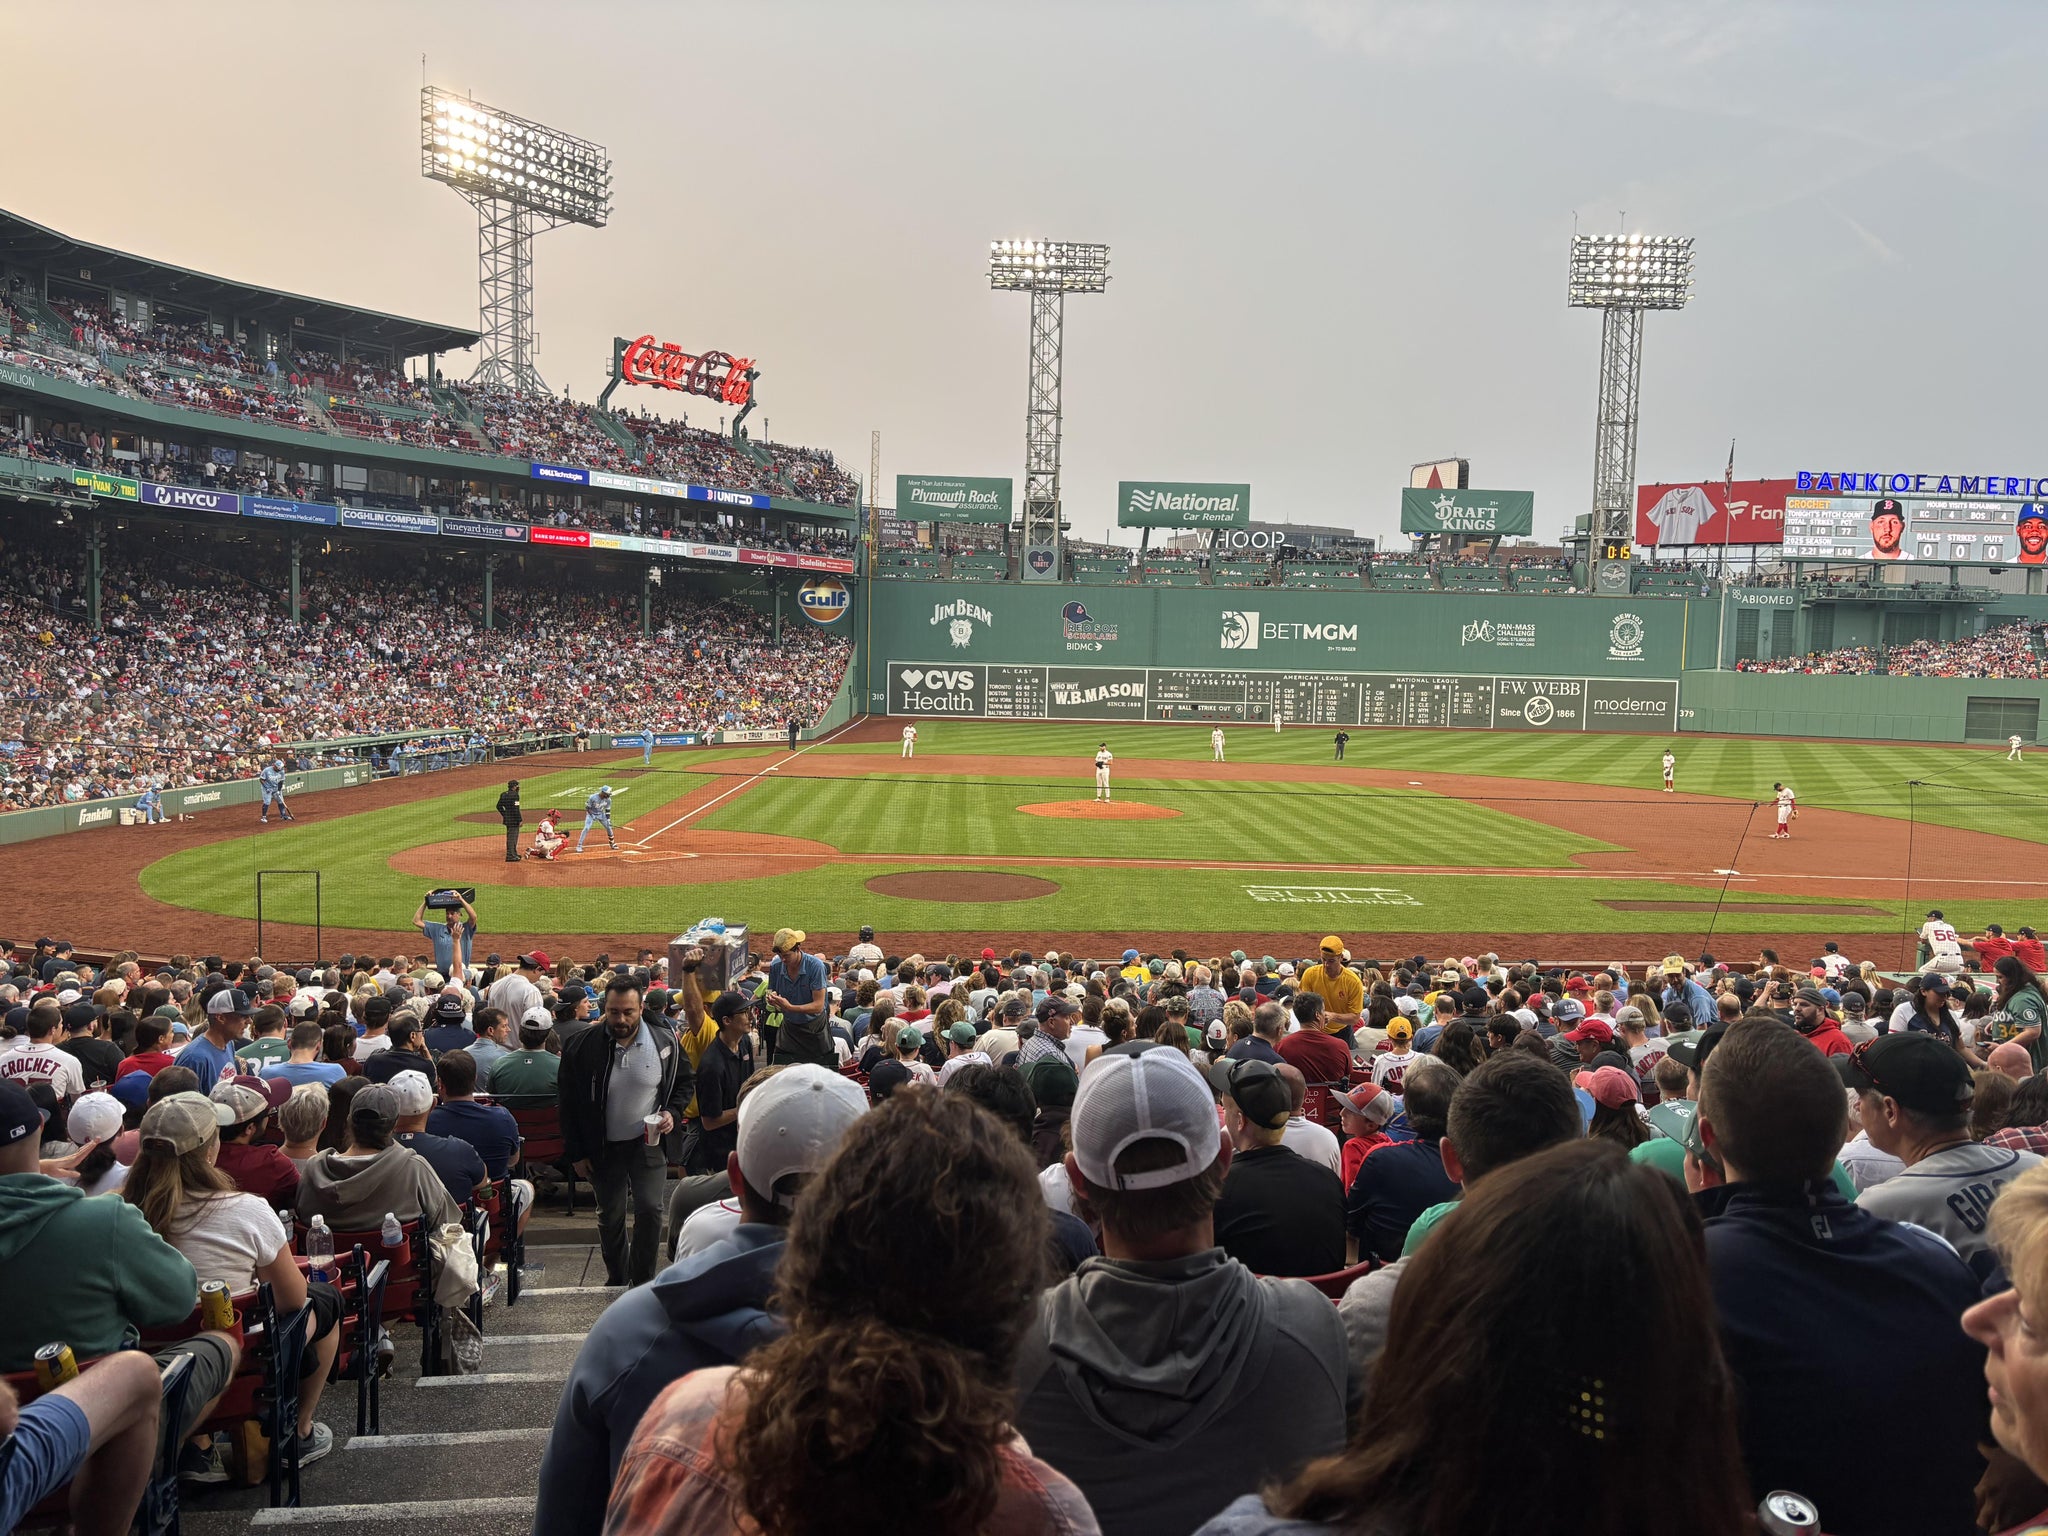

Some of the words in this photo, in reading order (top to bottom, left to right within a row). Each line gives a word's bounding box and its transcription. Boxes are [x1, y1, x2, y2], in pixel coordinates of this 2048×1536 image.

[622, 334, 757, 405] Coca-Cola
[920, 480, 933, 488] Than
[1796, 470, 1880, 493] BANK
[1889, 473, 1928, 494] OF
[121, 484, 137, 497] TIRE
[911, 488, 966, 503] Plymouth
[968, 489, 998, 504] Rock
[174, 492, 219, 507] HYCU
[717, 492, 753, 506] UNITED
[1788, 499, 1831, 509] CROCHET
[1926, 501, 1948, 509] MOUND
[1968, 502, 2001, 510] REMAINING
[1182, 512, 1200, 521] Car
[1202, 512, 1234, 522] Rental
[1434, 505, 1499, 520] DRAFT
[1680, 505, 1695, 516] SOX
[1787, 510, 1821, 518] TONIGHT'S
[1842, 511, 1865, 519] COUNT
[1919, 510, 1930, 518] KC
[1948, 510, 1955, 519] 4
[1970, 511, 1986, 520] BOS
[2001, 512, 2007, 521] 4
[343, 510, 384, 523] COGHLIN
[385, 513, 437, 527] COMPANIES
[1441, 517, 1497, 531] KINGS
[444, 522, 482, 535] vineyard
[482, 525, 504, 536] vines
[1791, 526, 1800, 534] 13
[1816, 526, 1826, 535] 10
[1841, 527, 1852, 535] 77
[534, 532, 549, 540] BANK
[555, 534, 577, 543] AMERICA
[1196, 530, 1286, 550] WHOOP
[1786, 537, 1804, 545] 2025
[1916, 533, 1941, 542] BALLS
[1947, 534, 1977, 542] STRIKES
[1983, 535, 2004, 543] OUTS
[750, 552, 767, 562] Ninety
[1607, 545, 1631, 560] 0:15
[1801, 547, 1817, 555] 2.21
[1837, 547, 1853, 556] 1.08
[1923, 543, 1933, 557] 0
[1955, 544, 1965, 558] 0
[1987, 545, 1997, 559] 0
[800, 590, 846, 607] Gulf
[1741, 594, 1794, 606] ABIOMED
[929, 603, 955, 626] JIM
[955, 598, 994, 628] BEAM
[1611, 613, 1632, 625] IBEW
[1631, 614, 1644, 626] 103
[1067, 623, 1091, 633] RED
[1094, 624, 1118, 633] SOX
[1263, 622, 1358, 641] BETMGM
[1496, 623, 1536, 631] PAN-MASS
[1067, 632, 1118, 641] SCHOLARS
[1066, 642, 1094, 651] BIDMC
[924, 669, 975, 691] CVS
[1532, 682, 1581, 696] WEBB
[872, 692, 885, 701] 310
[903, 690, 974, 711] Health
[1594, 697, 1668, 712] moderna
[1500, 707, 1521, 717] Since
[1556, 709, 1576, 718] 1866
[1679, 709, 1695, 718] 379
[748, 731, 763, 740] TRULY
[286, 781, 305, 793] TICKET
[183, 789, 222, 805] smartwater
[78, 806, 113, 826] franklin
[1215, 1029, 1223, 1039] B
[1998, 1023, 2019, 1039] 34
[0, 1057, 62, 1079] CROCHET
